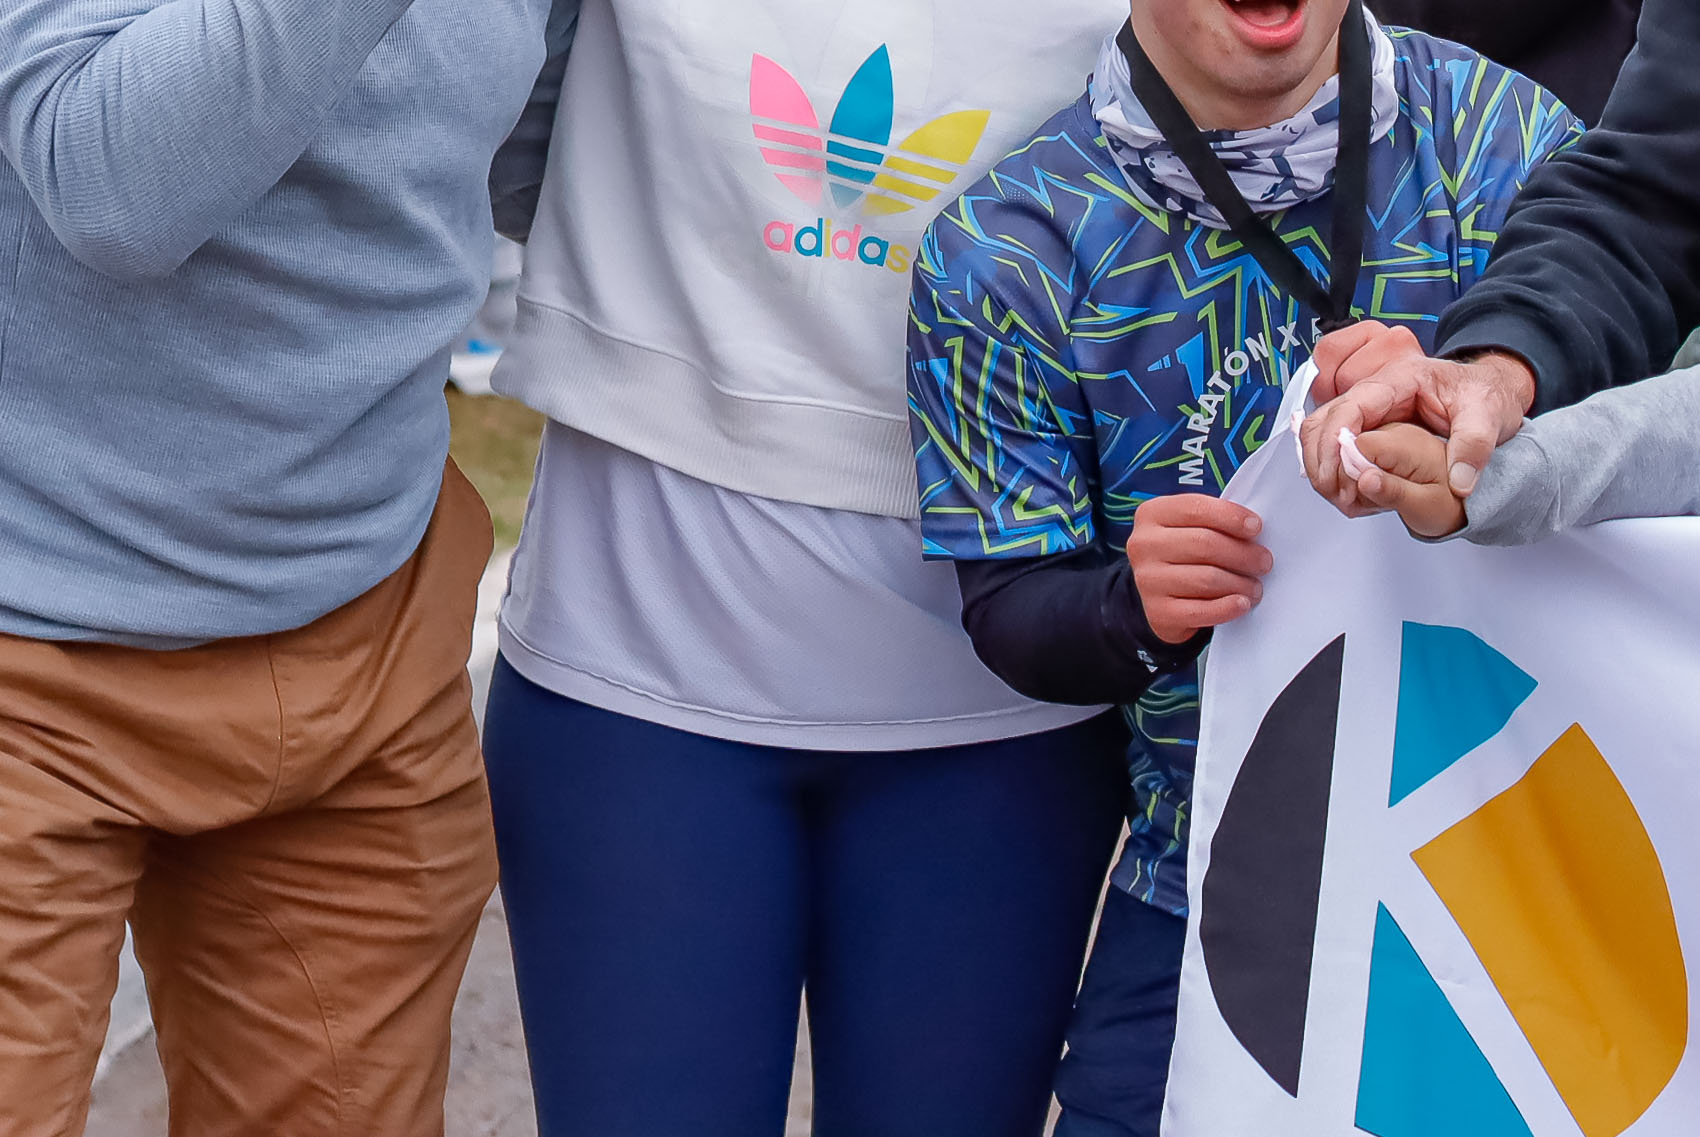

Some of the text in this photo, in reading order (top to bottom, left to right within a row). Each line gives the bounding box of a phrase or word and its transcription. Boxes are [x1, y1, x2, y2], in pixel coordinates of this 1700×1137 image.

[763, 217, 911, 273] adidas
[1179, 320, 1301, 485] MARATÓN X
